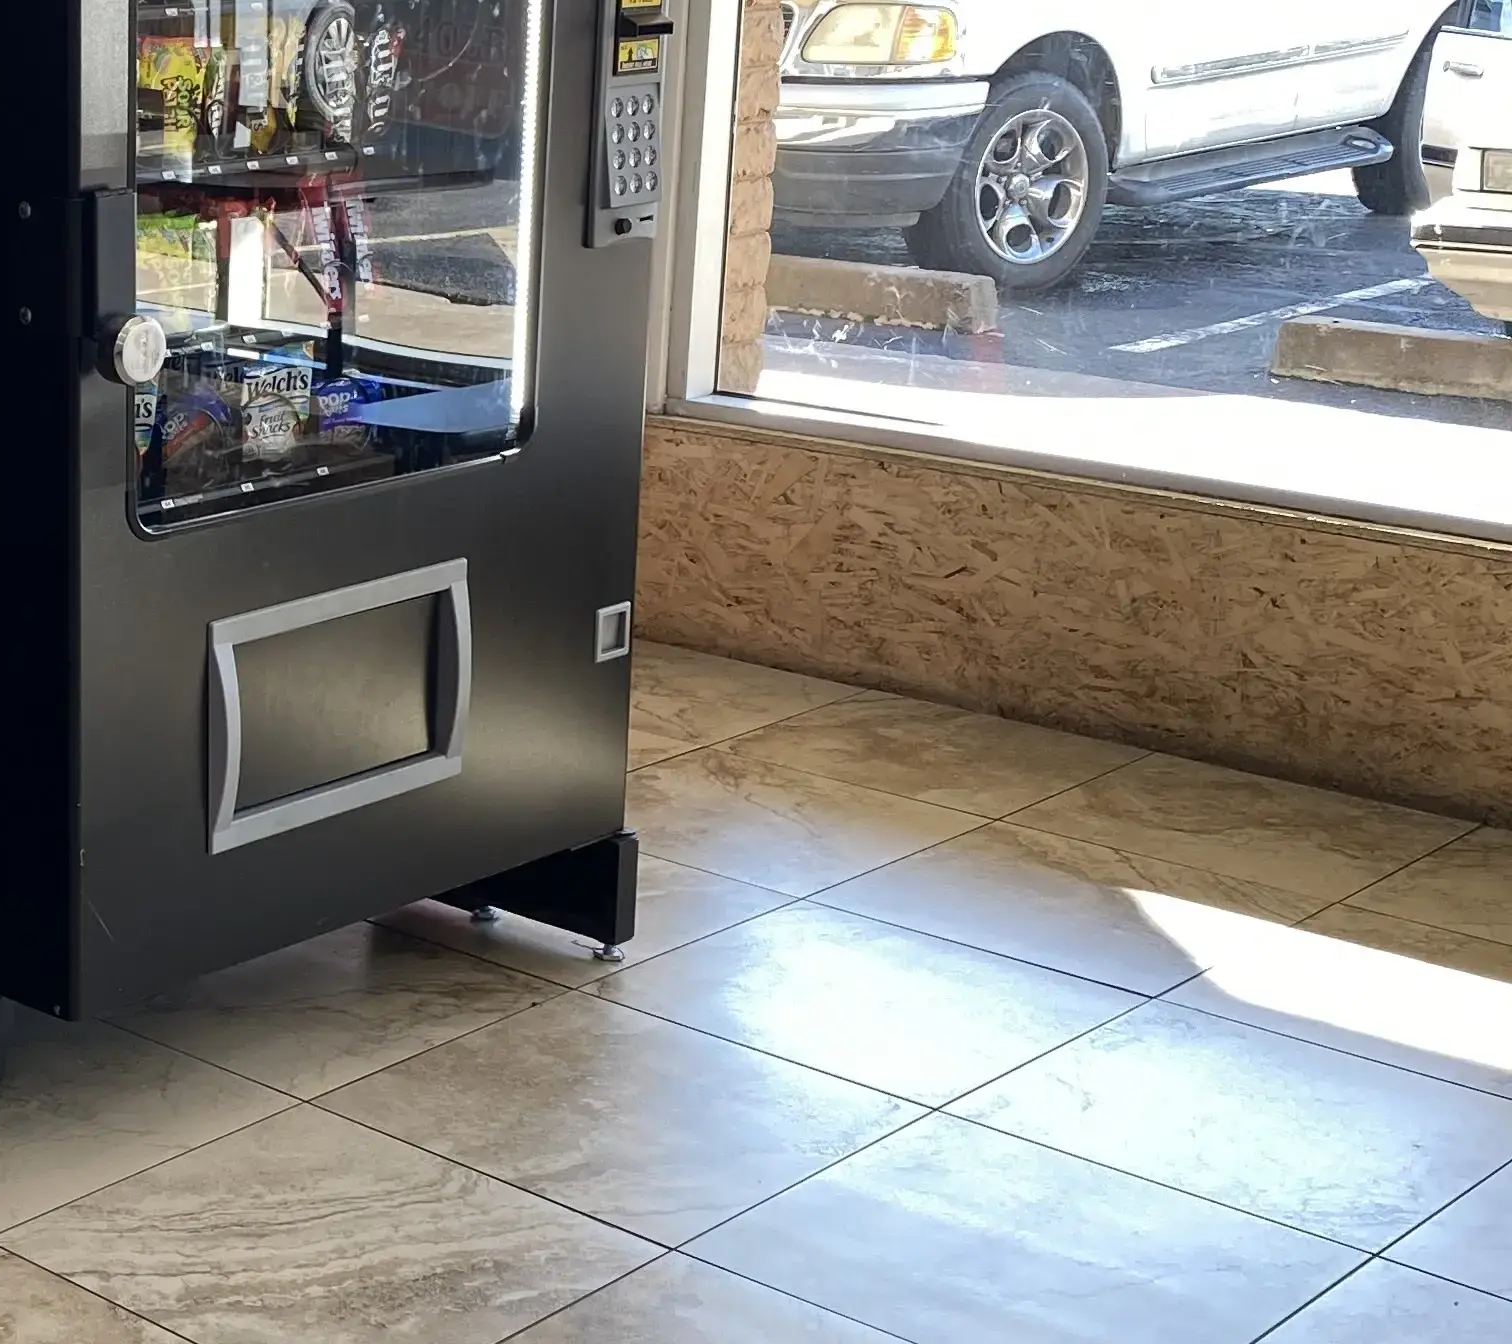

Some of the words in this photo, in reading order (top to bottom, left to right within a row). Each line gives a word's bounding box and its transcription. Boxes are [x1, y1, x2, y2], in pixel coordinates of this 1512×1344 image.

[246, 370, 309, 402] Welch's
[259, 411, 285, 427] Fruit
[252, 422, 291, 439] Snacks
